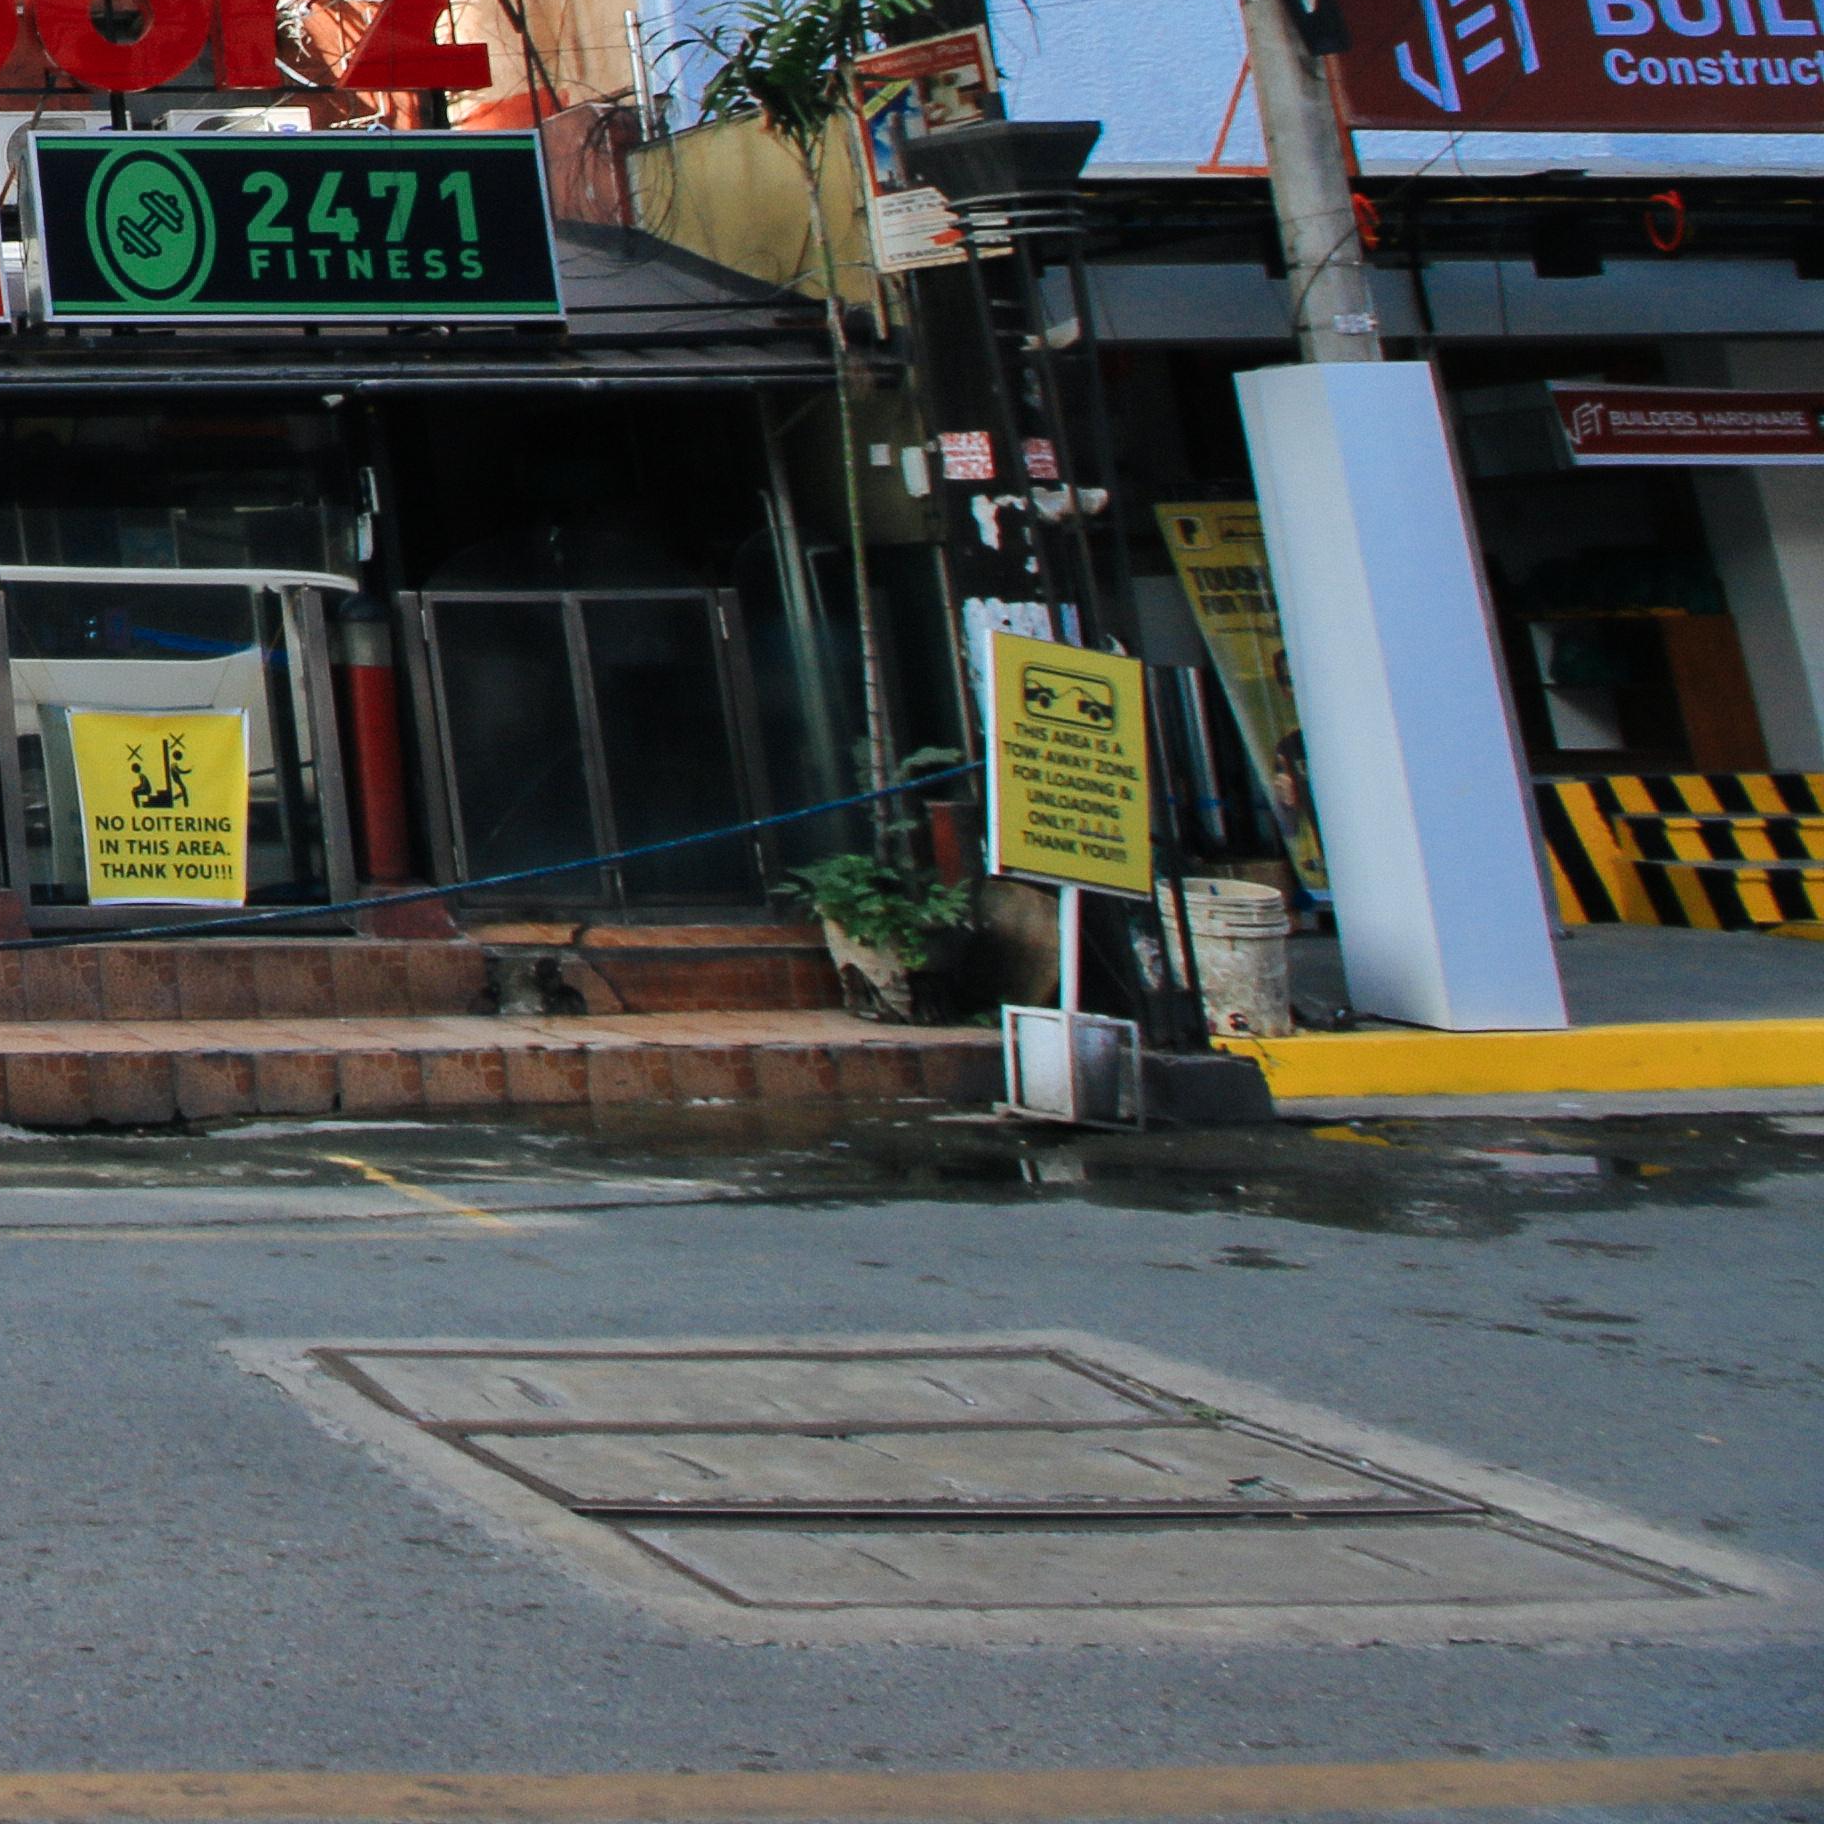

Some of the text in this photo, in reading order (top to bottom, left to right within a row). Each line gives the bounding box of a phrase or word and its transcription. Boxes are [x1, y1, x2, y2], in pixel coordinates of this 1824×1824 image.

[242, 170, 479, 244] 2471
[250, 247, 486, 280] FITNESS
[1609, 410, 1698, 426] BUILDERS
[1702, 411, 1809, 427] HARDWARE
[1013, 721, 1123, 756] THIS AREA IS A
[1002, 740, 1091, 770] TOW-AWAY
[1011, 764, 1042, 782] FOR
[1046, 769, 1116, 798] LOADING
[1026, 787, 1120, 819] UNLOADING
[95, 815, 232, 833] NO LOITERING
[99, 839, 232, 856] IN THIS AREA.
[1022, 829, 1078, 854] THANK
[100, 862, 233, 880] THANK YOU!!!
